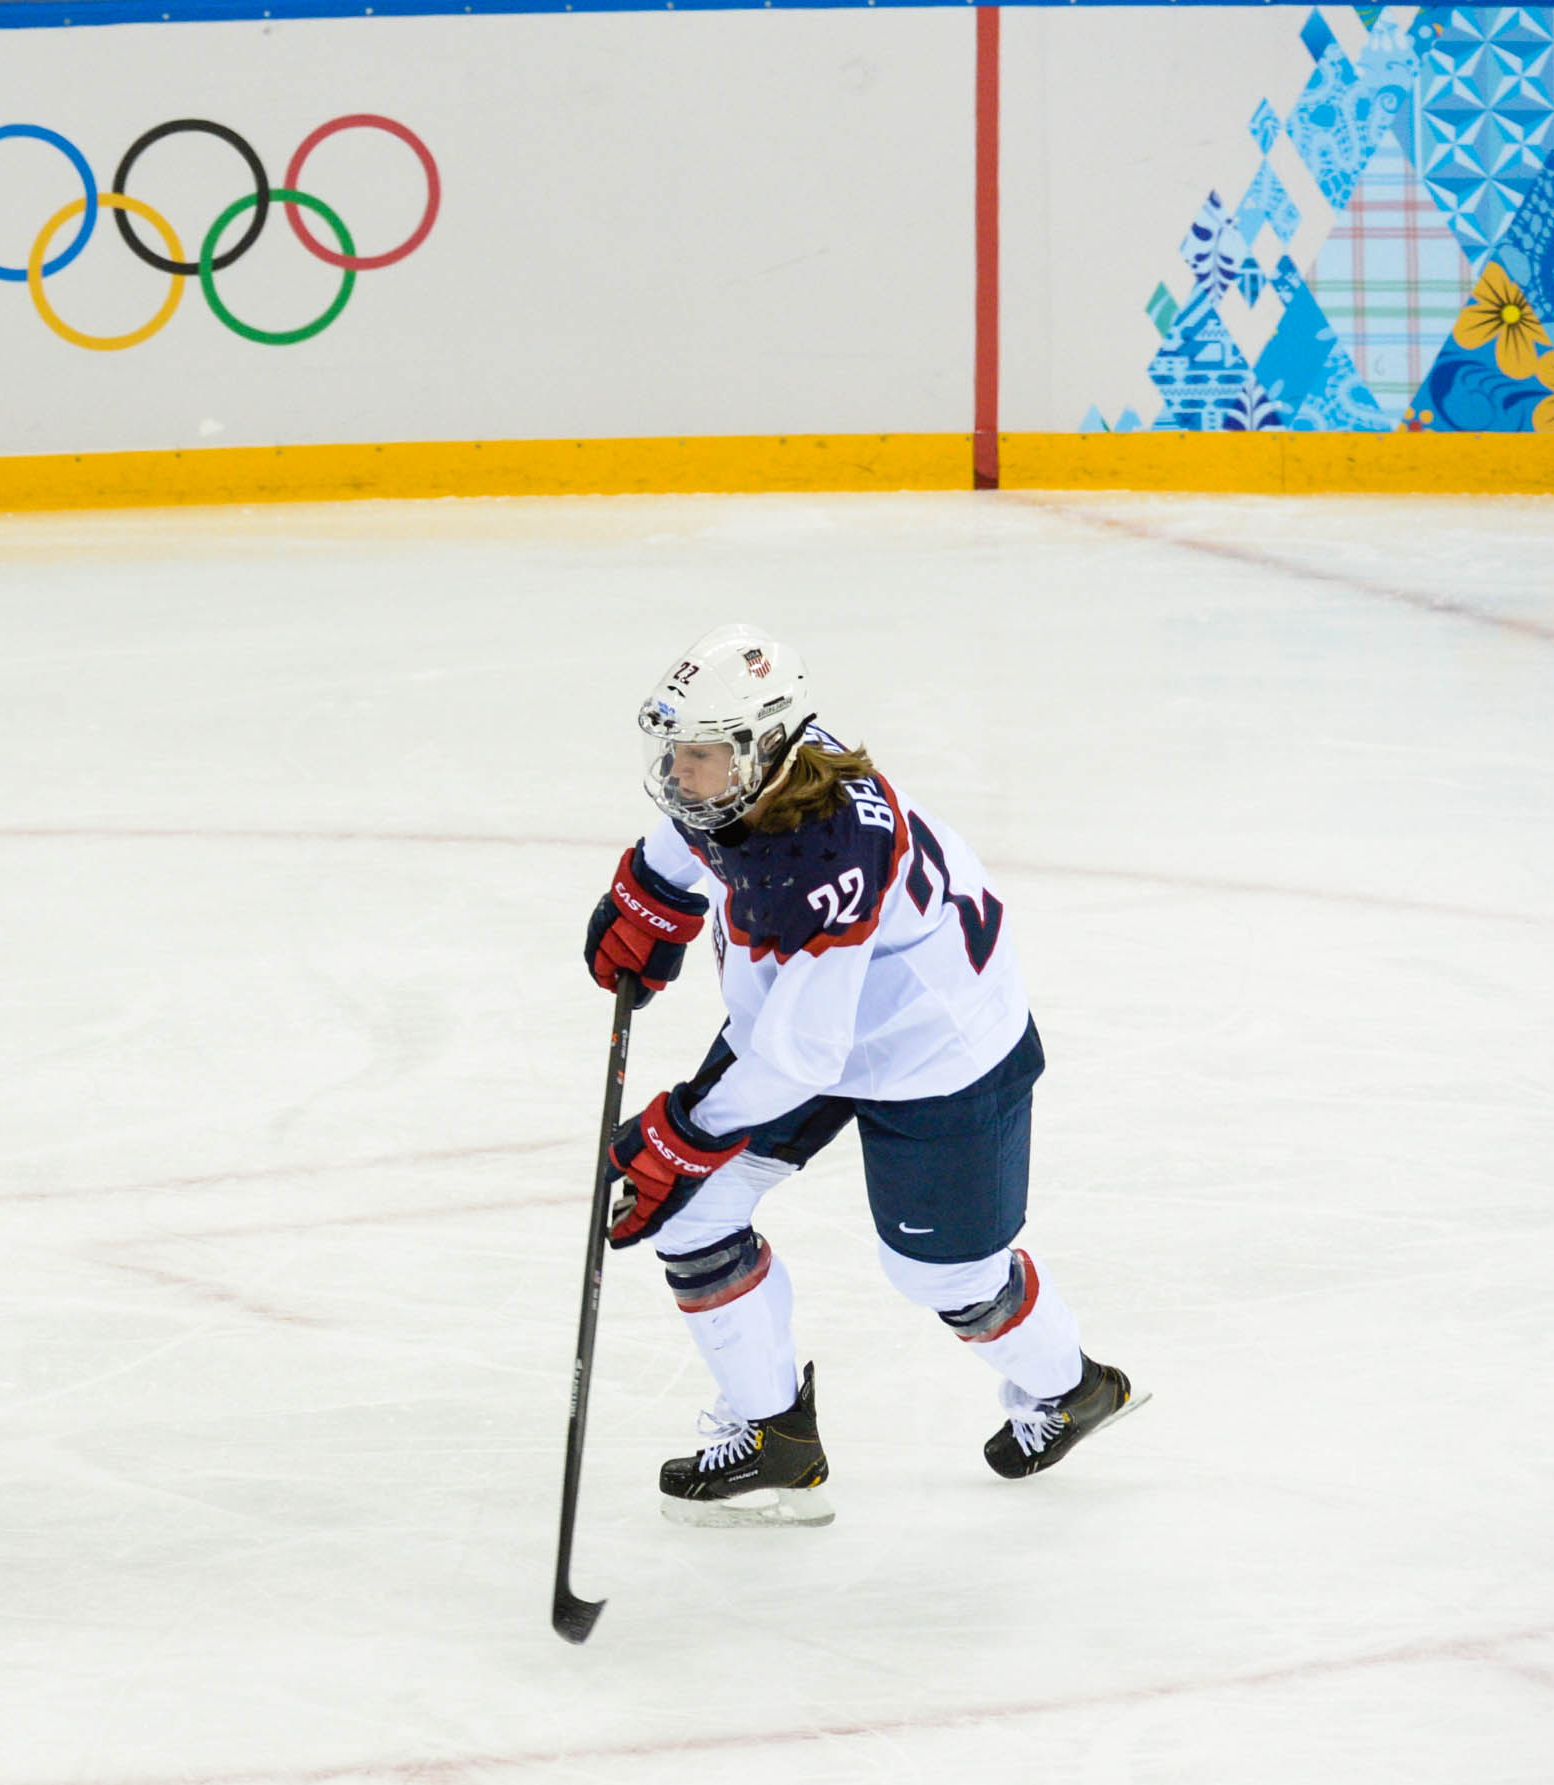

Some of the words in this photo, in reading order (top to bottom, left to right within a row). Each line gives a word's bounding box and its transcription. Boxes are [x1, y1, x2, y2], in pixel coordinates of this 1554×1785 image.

[673, 661, 700, 685] 22
[614, 881, 678, 933] EASTON
[806, 866, 865, 929] 22
[647, 1126, 712, 1174] EASTON
